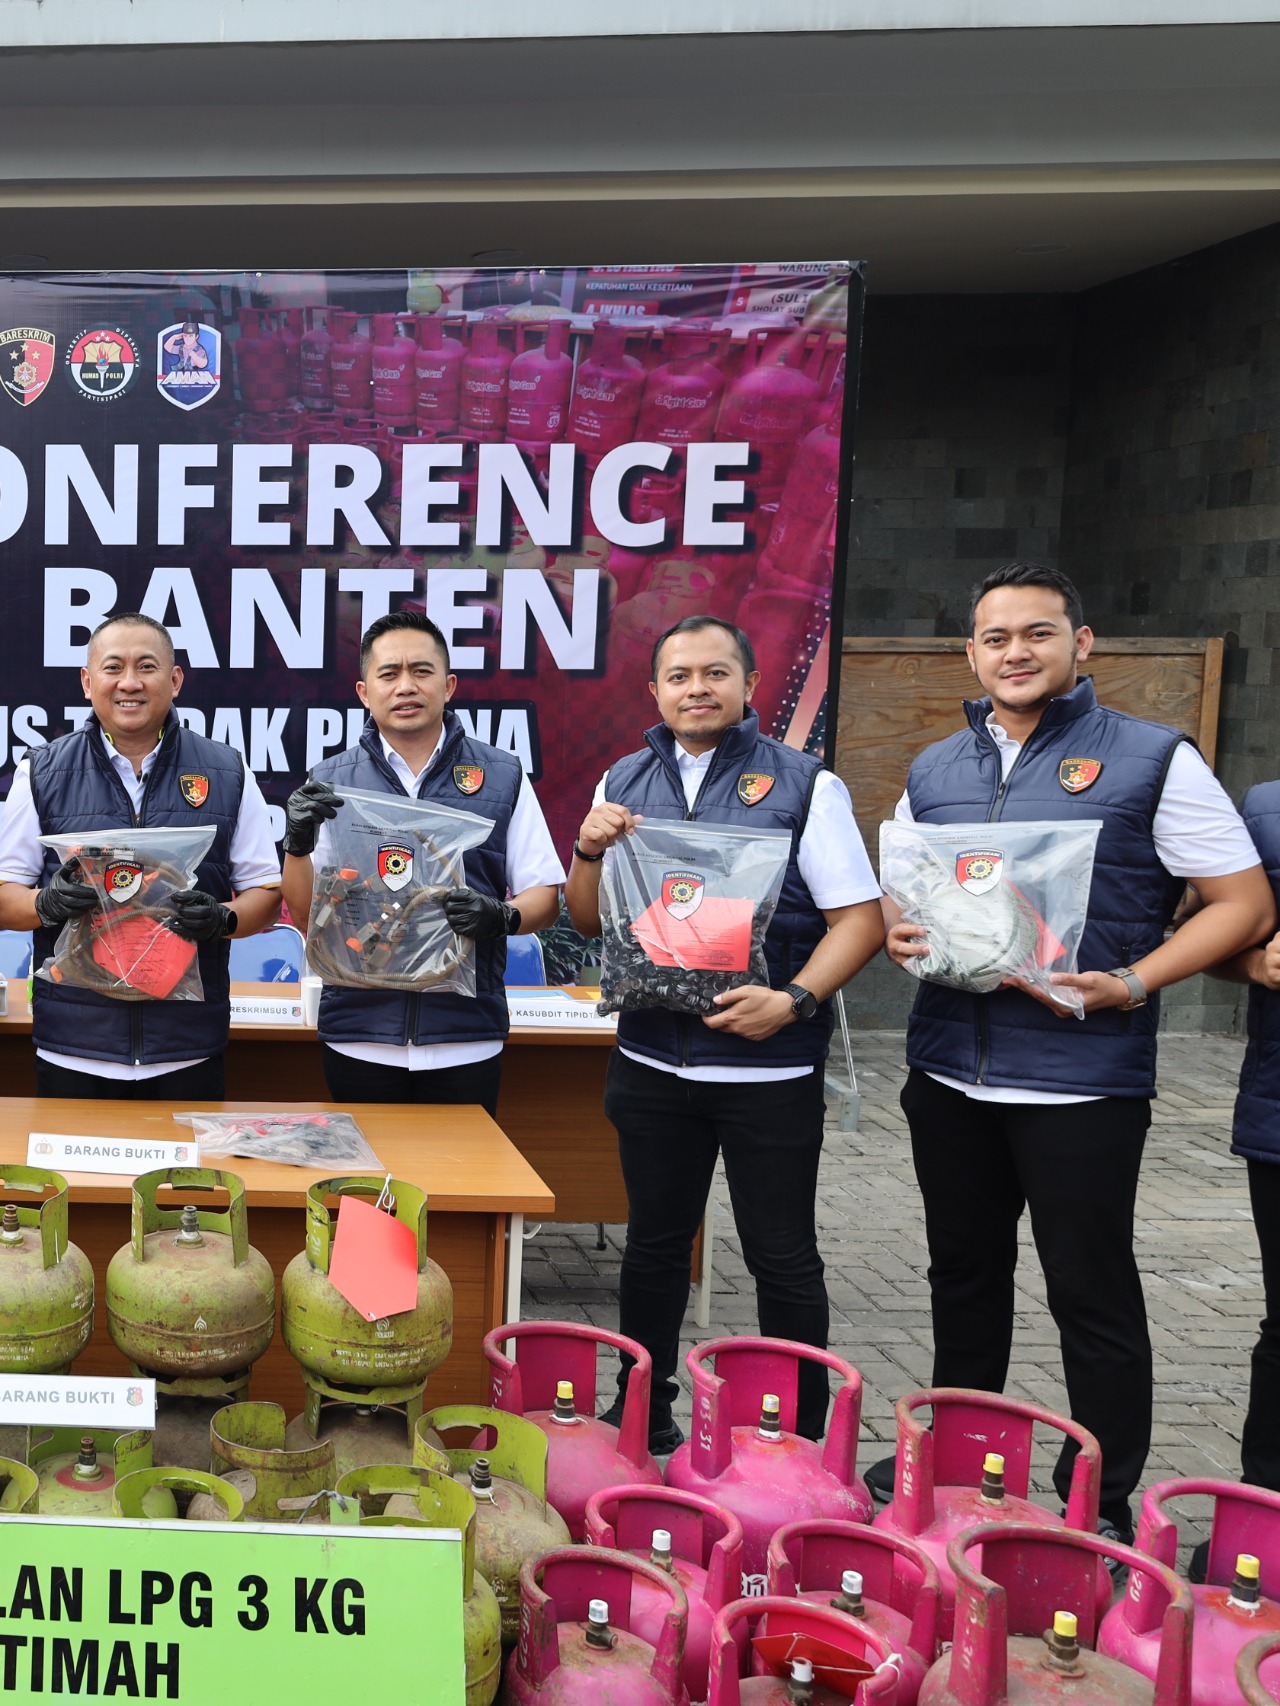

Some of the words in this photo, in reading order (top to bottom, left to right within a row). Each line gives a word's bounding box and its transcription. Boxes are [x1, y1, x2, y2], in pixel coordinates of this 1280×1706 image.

[586, 283, 627, 291] KEPATUHAN
[629, 283, 645, 291] DAN
[646, 284, 693, 292] KESETIAAN
[736, 297, 744, 306] 5
[771, 293, 808, 304] (SULI
[0, 329, 50, 343] BARESKRIM
[165, 371, 216, 385] AMAN
[78, 390, 127, 402] PARTISIPASI
[43, 567, 600, 670] BANTEN
[306, 708, 534, 774] PINA
[666, 873, 702, 881] IDENTIFIKASI
[516, 1010, 562, 1018] KASUBDIT
[565, 1011, 607, 1019] TIPIDT
[64, 1144, 121, 1158] BARANG
[125, 1147, 166, 1160] BUKTI
[66, 1390, 116, 1406] BUKTI
[491, 1377, 503, 1409] 12-
[108, 1569, 214, 1628] LPG
[237, 1574, 270, 1631] 3
[294, 1577, 367, 1636] KG
